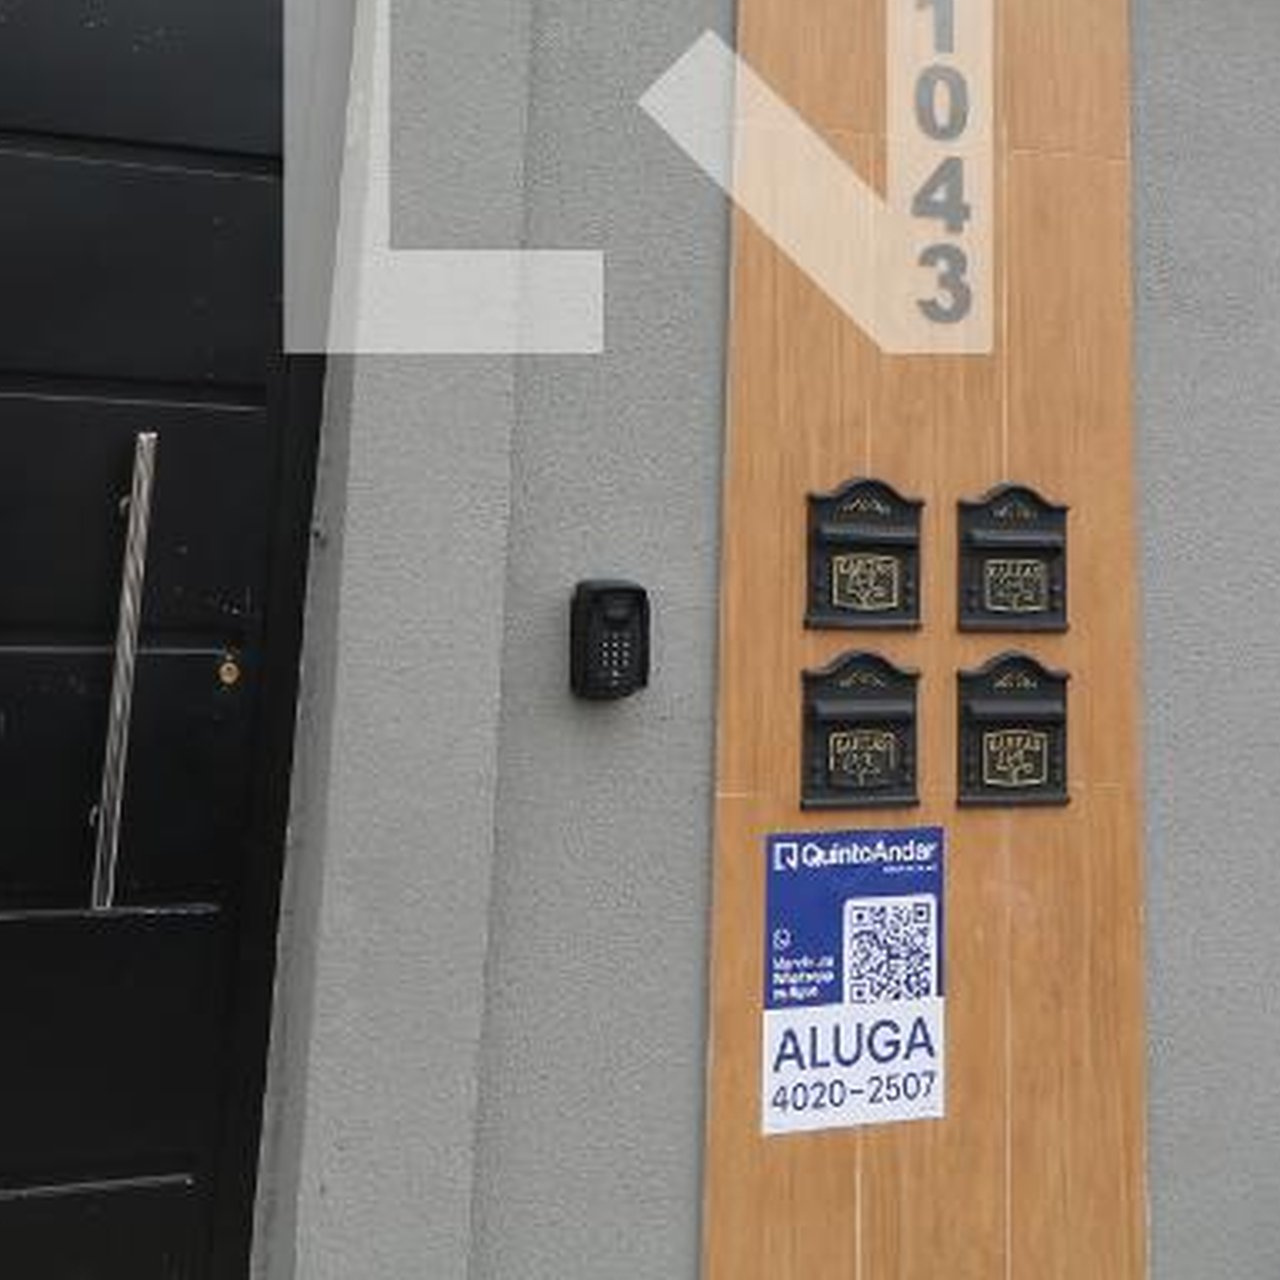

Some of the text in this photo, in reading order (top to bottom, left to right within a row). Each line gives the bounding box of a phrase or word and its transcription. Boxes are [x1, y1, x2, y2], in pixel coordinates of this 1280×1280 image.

[801, 839, 938, 868] QuintoAndar
[773, 1016, 936, 1073] ALUGA
[772, 1071, 937, 1114] 4020-2507
